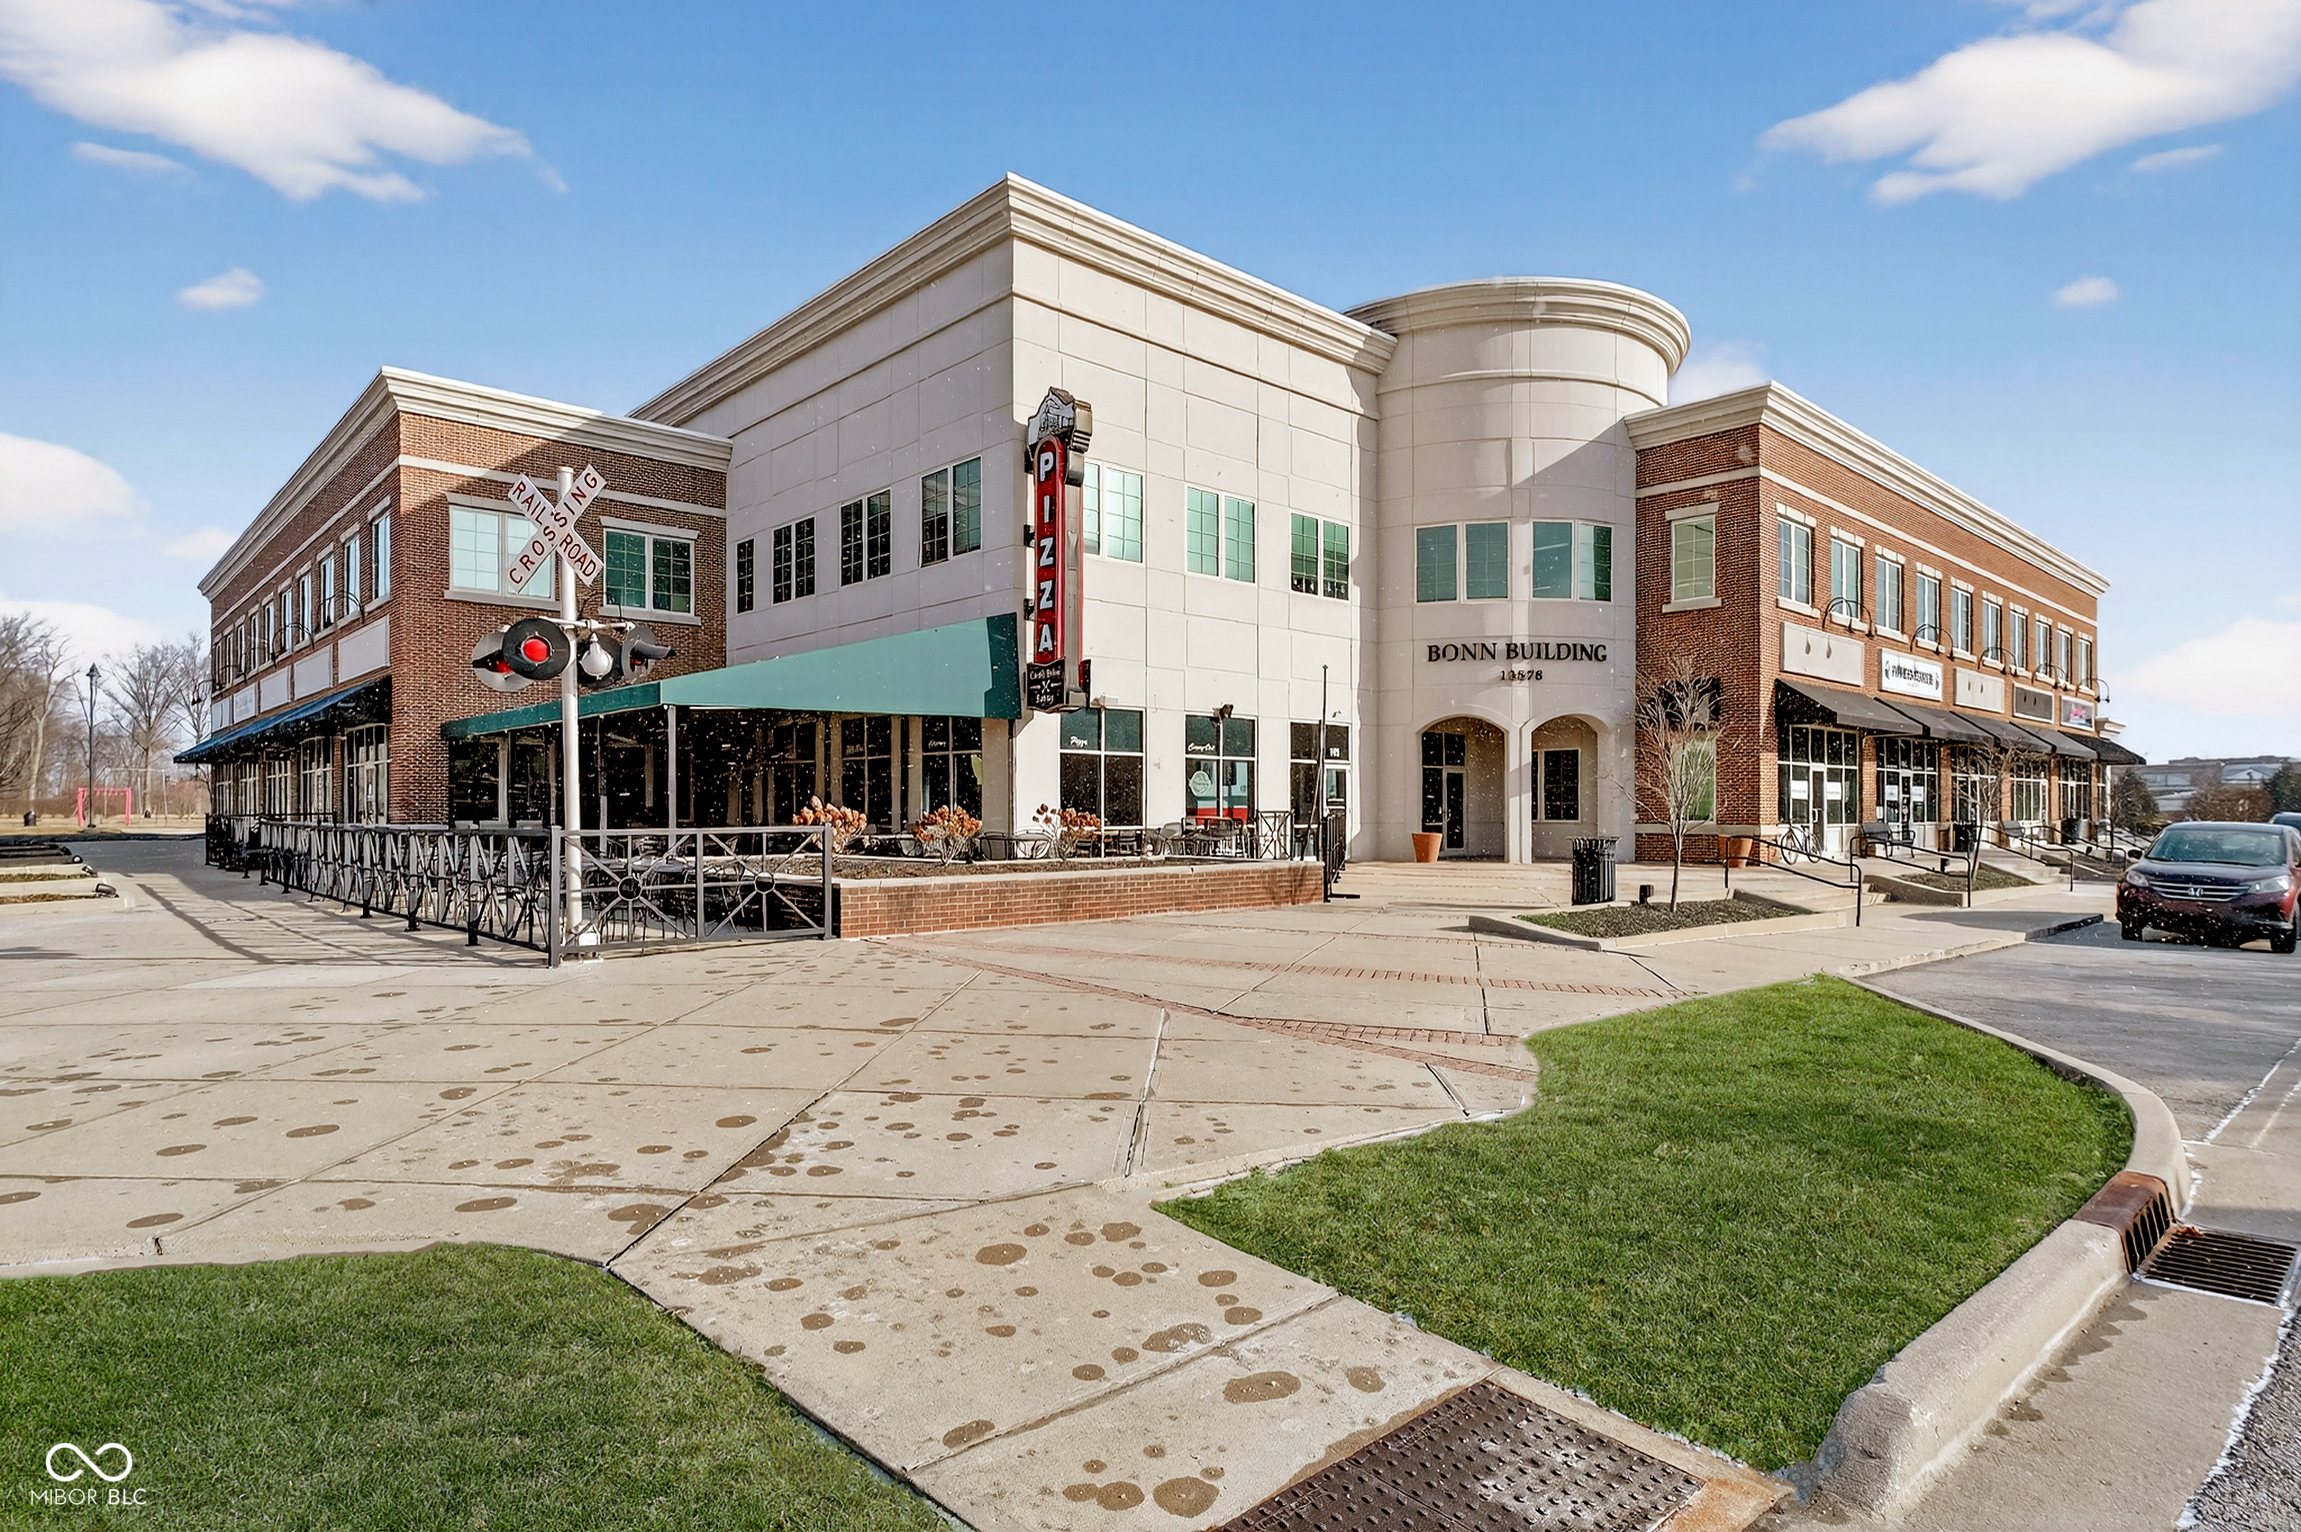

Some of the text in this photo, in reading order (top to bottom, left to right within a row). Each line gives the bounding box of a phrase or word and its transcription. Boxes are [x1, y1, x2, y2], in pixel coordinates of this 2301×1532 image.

[508, 471, 599, 586] CROSSING
[1038, 451, 1054, 653] PIZZA
[1427, 642, 1608, 662] BONN BUILDING
